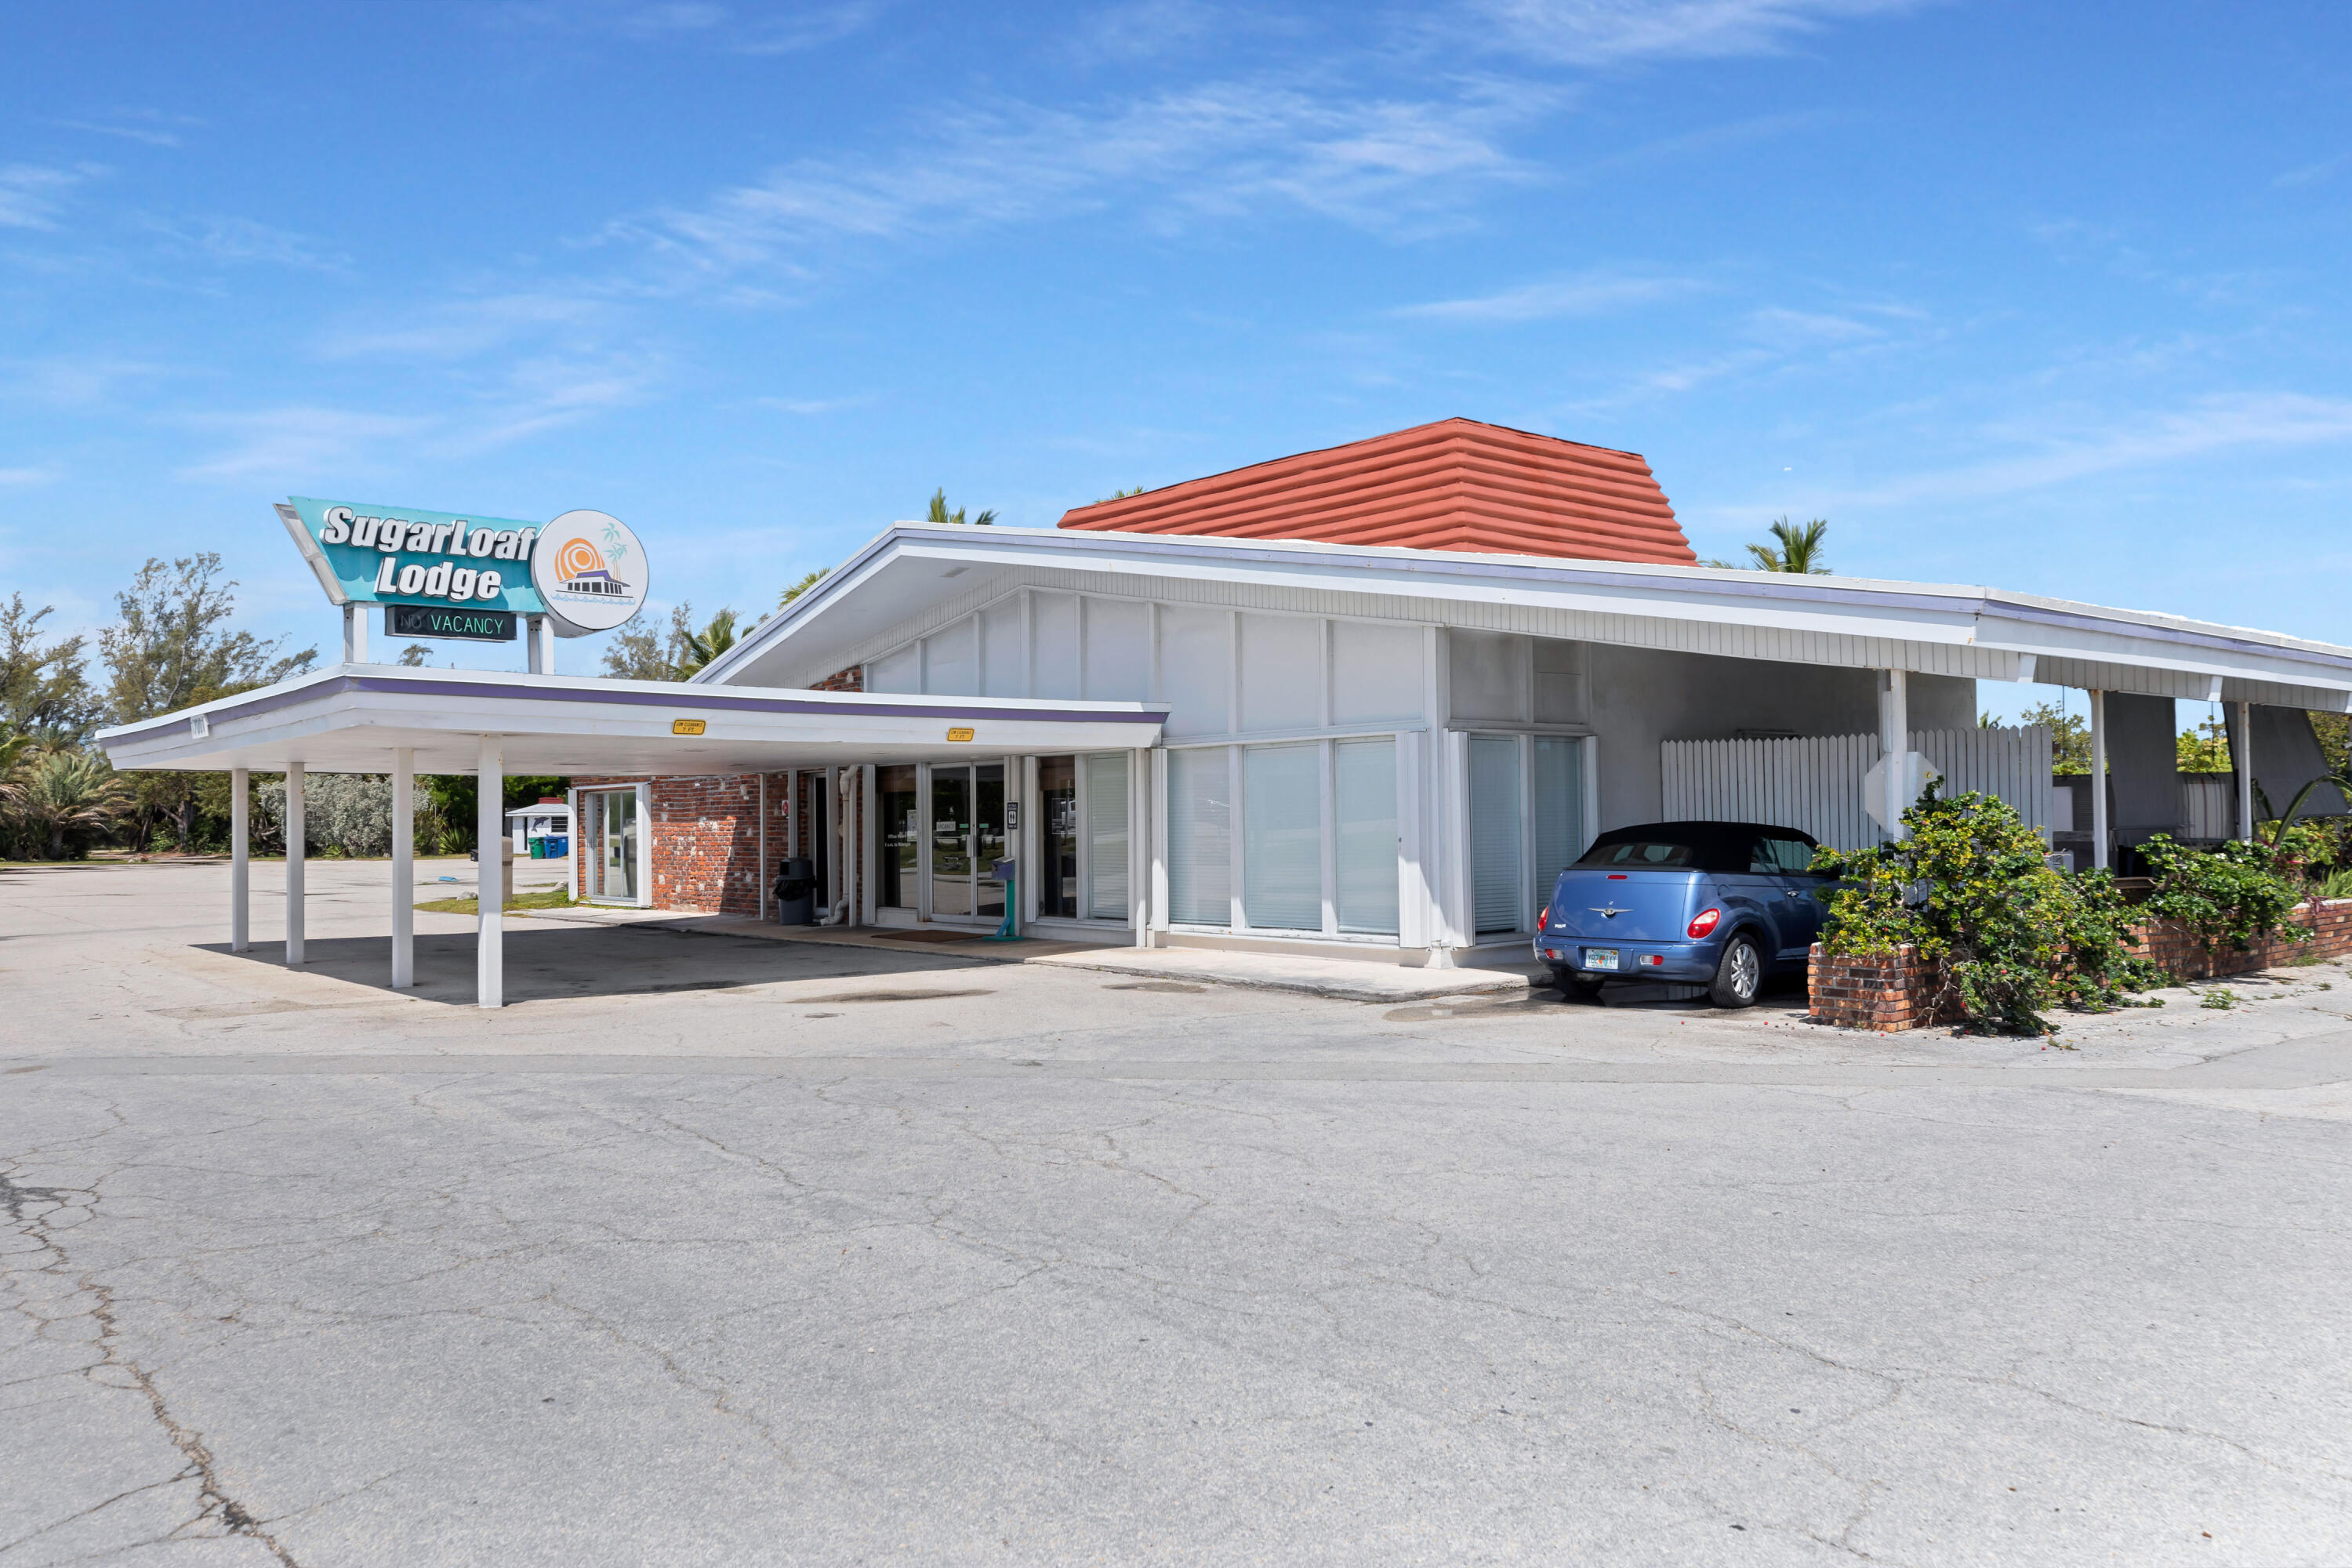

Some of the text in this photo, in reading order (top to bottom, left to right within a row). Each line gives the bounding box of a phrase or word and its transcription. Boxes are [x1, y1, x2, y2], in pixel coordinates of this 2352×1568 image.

[319, 506, 537, 561] SugarLoaf
[374, 556, 502, 601] Lodge
[401, 614, 503, 634] NO VACANCY
